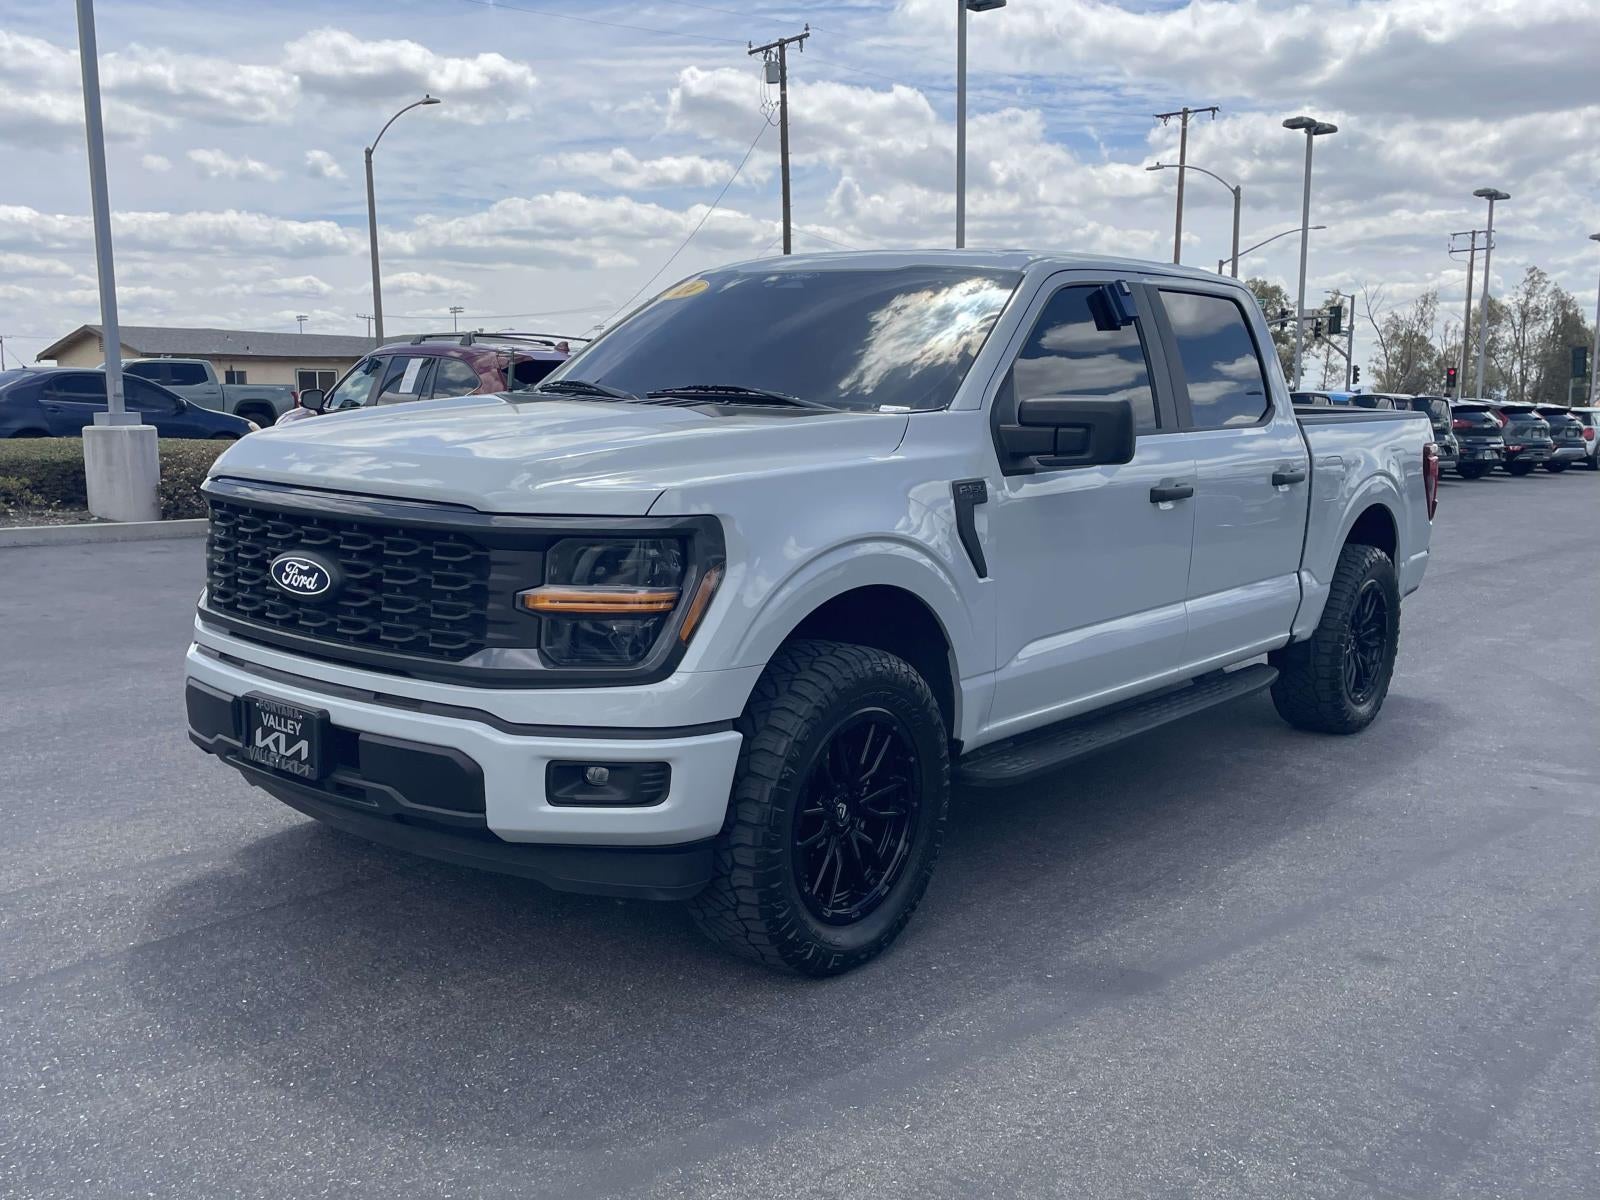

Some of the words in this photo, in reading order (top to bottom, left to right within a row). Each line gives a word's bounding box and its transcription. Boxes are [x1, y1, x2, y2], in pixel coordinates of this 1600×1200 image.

[282, 562, 318, 590] Ford
[261, 711, 302, 736] VALLEY
[255, 727, 309, 761] KIA
